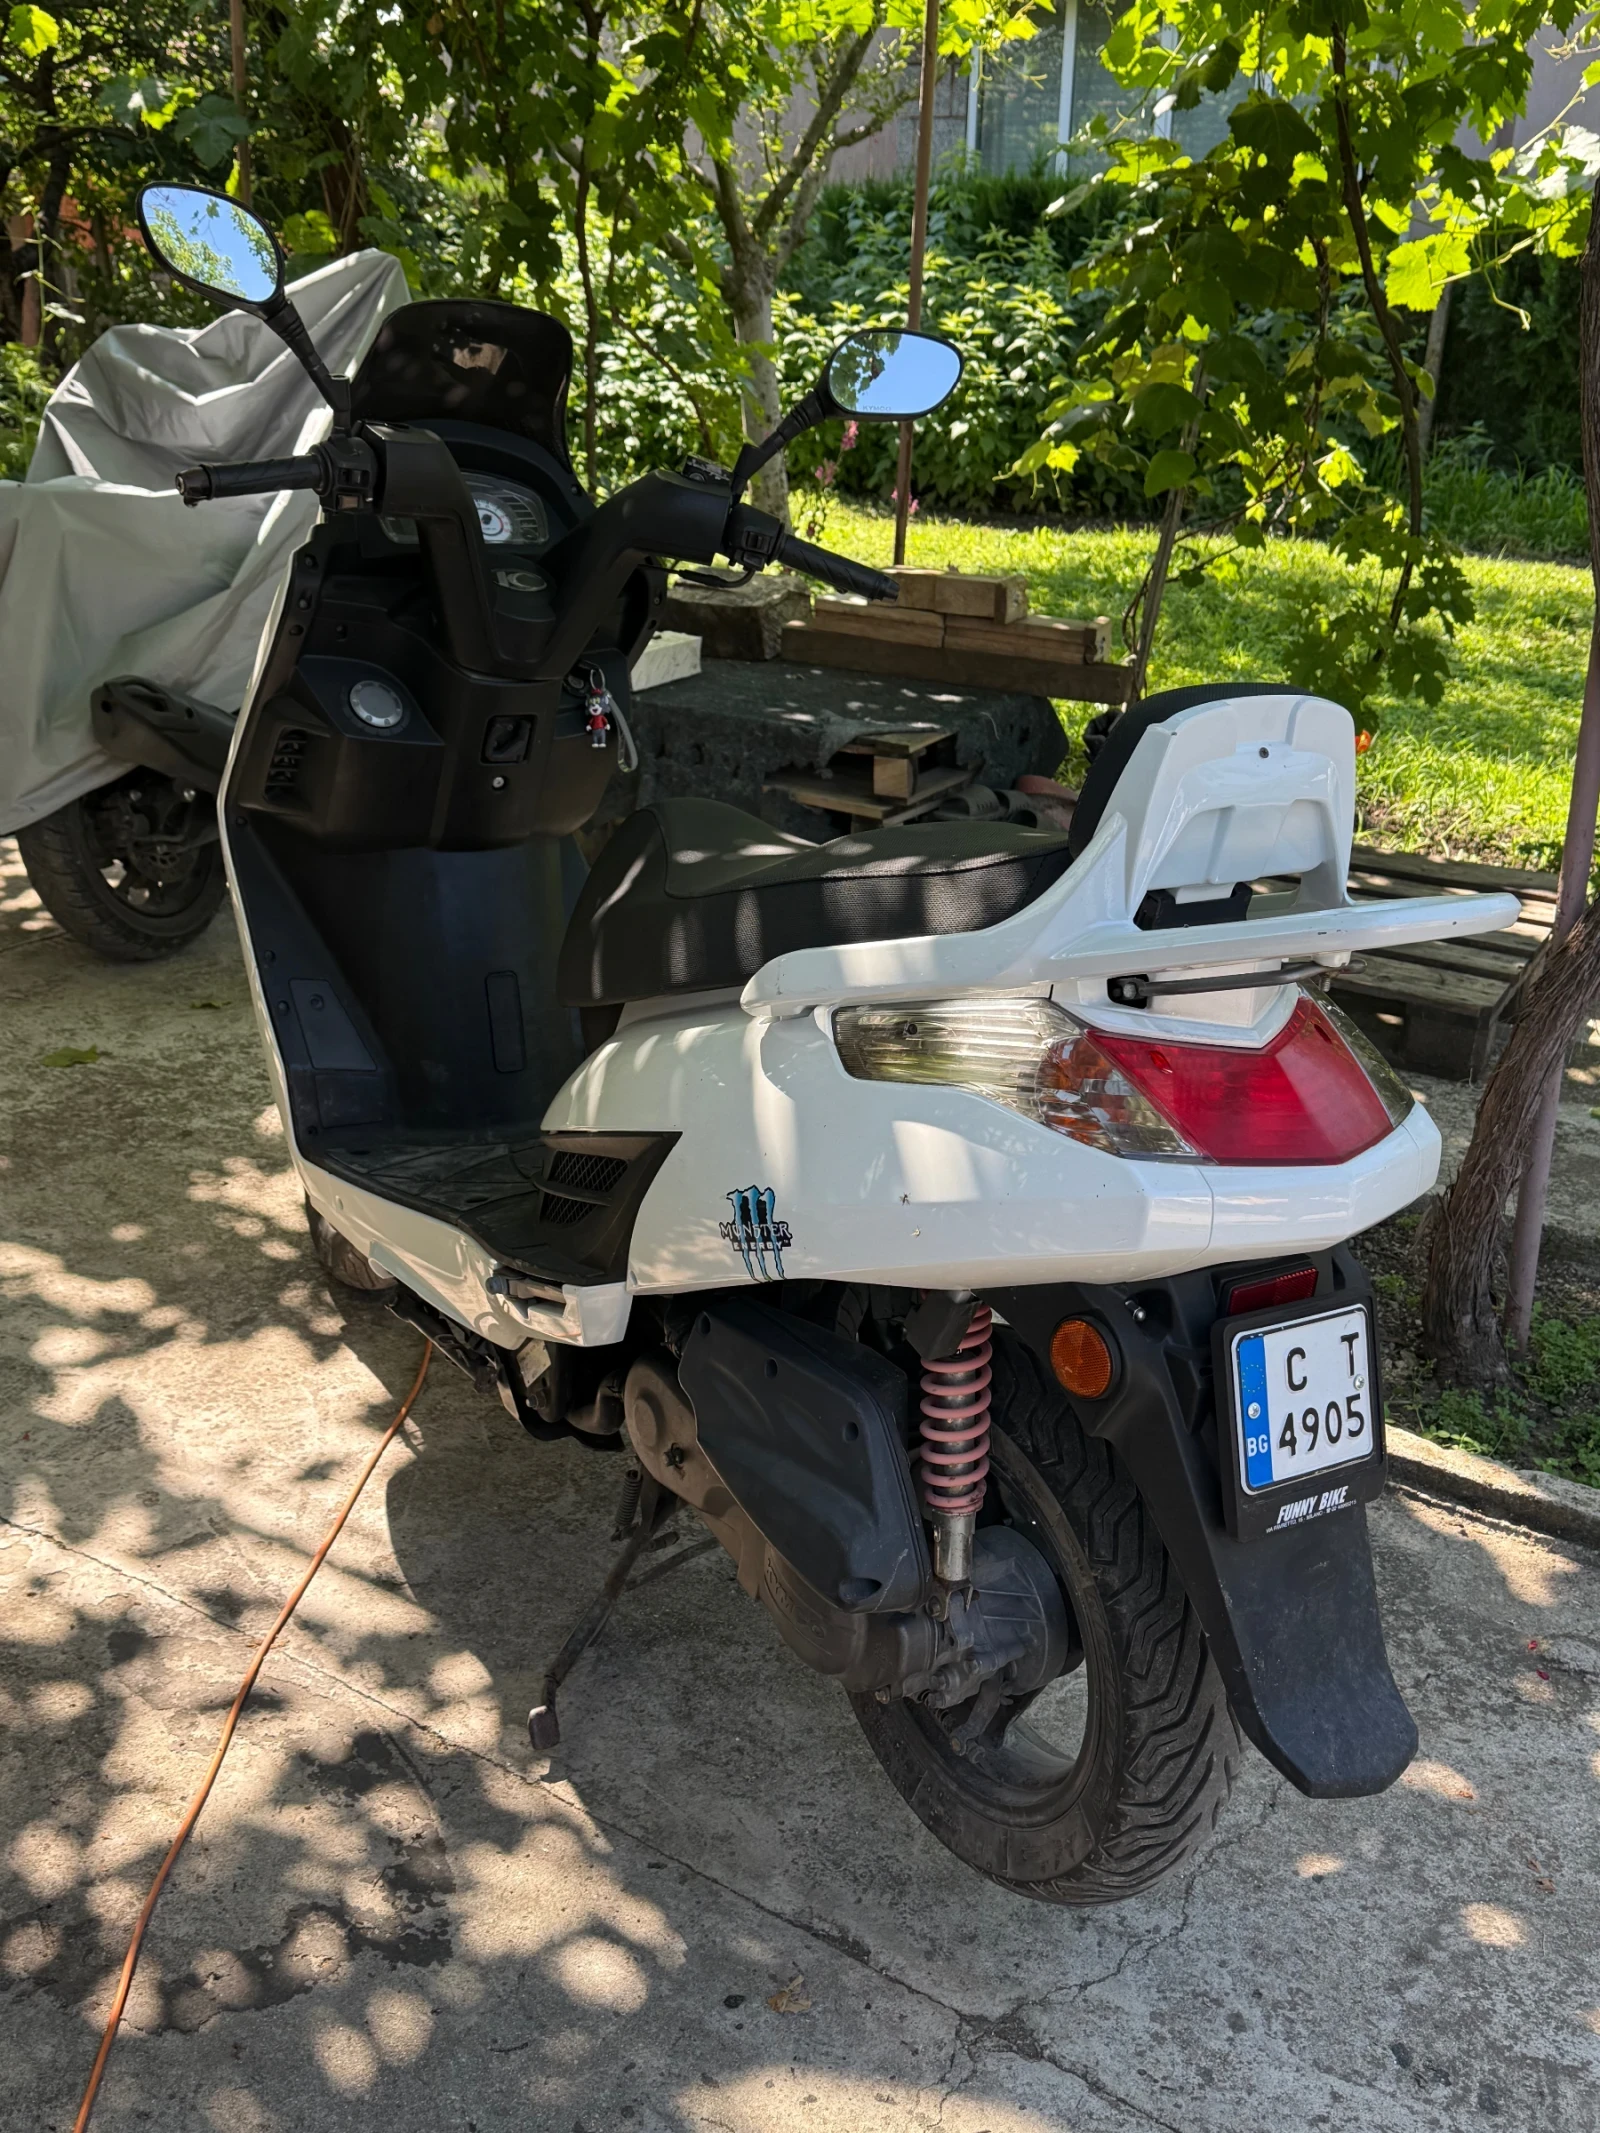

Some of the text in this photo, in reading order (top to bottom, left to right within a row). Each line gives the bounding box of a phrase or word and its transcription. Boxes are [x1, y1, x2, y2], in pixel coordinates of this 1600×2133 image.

[1287, 1332, 1359, 1391] C T
[1247, 1434, 1268, 1457] BG
[1279, 1393, 1365, 1456] 4905
[1277, 1486, 1349, 1524] FUNNY BIKE
